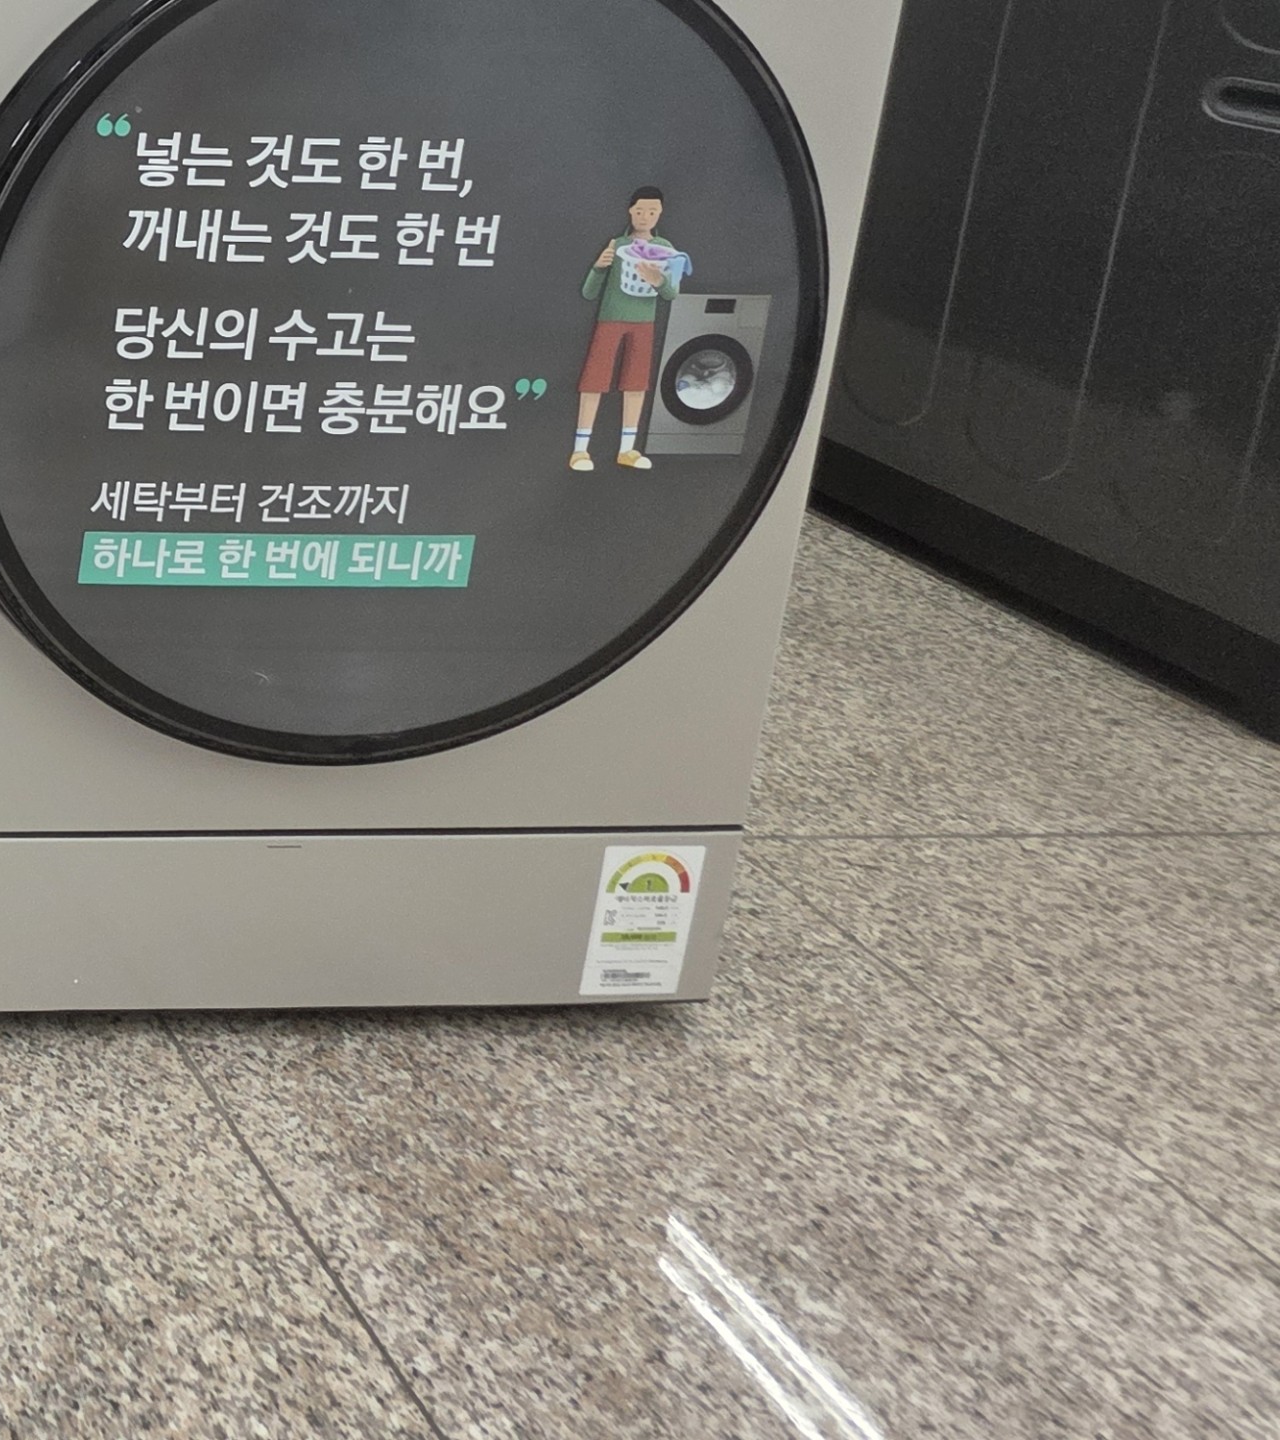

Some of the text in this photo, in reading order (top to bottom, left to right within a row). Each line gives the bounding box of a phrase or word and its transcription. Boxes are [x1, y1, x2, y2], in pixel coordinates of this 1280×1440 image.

[246, 134, 342, 188] 것도
[358, 136, 407, 191] 한
[418, 137, 474, 199] 번,
[122, 207, 501, 267] 꺼내는 것도 한 번
[113, 306, 416, 362] 당신의 수고는
[104, 378, 154, 432] 한
[164, 380, 307, 434] 번이면
[90, 480, 411, 524] 세탁부터 건조까지
[93, 537, 462, 582] 하나로 한 번에 되니까
